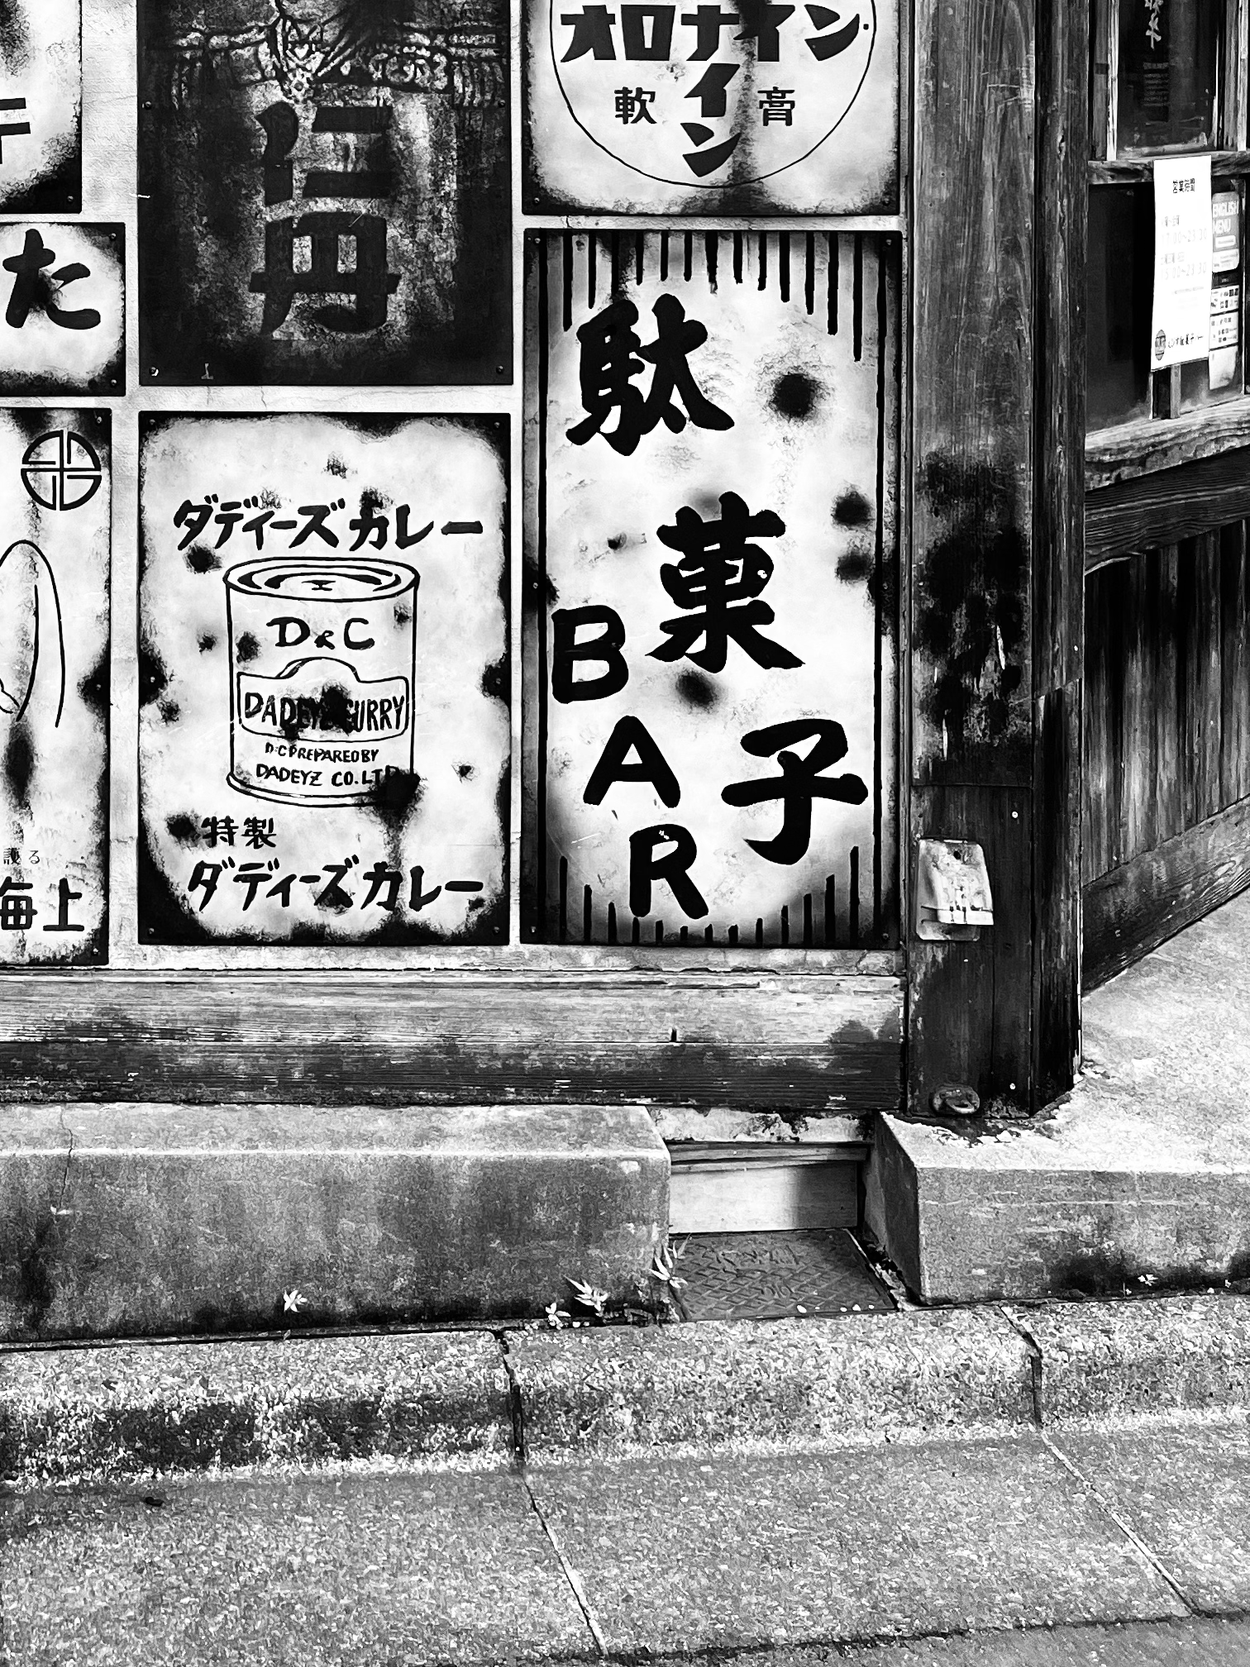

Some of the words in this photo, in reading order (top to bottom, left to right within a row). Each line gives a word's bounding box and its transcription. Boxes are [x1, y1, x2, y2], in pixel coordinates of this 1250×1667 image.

[250, 101, 402, 336] 仁丹
[565, 293, 870, 866] 駄菓子
[200, 815, 277, 850] 特製
[551, 605, 709, 921] BAR
